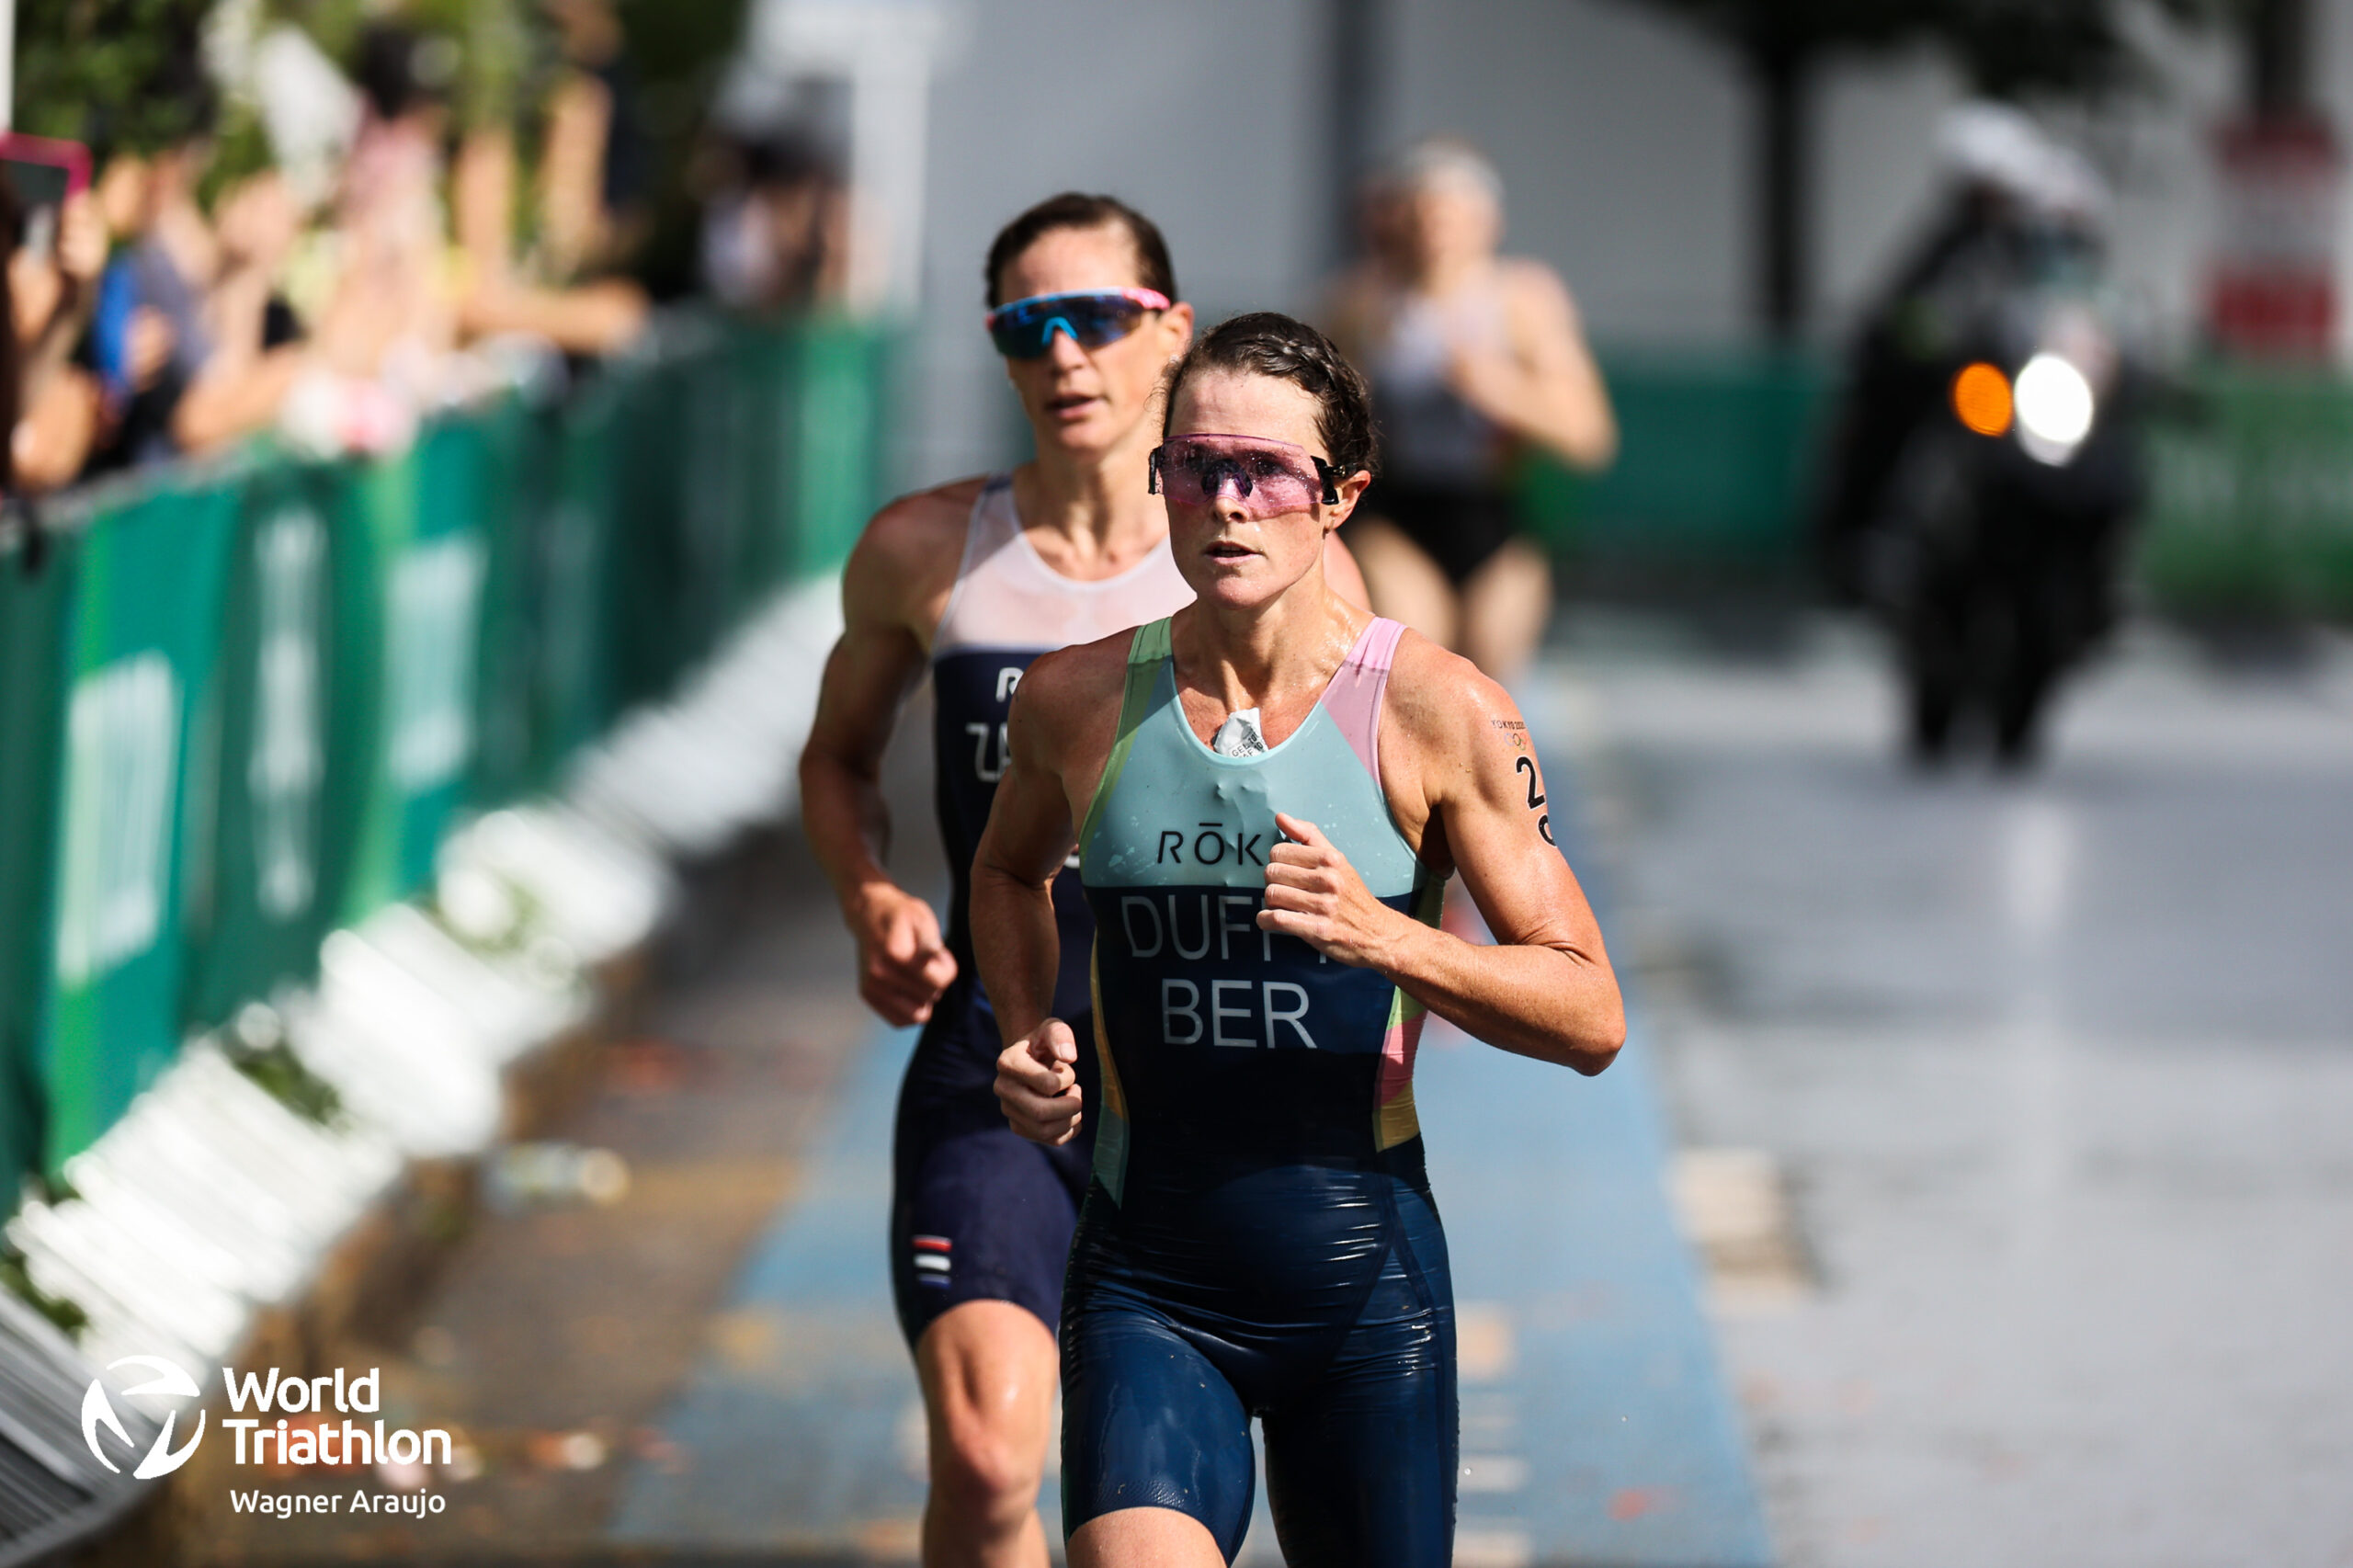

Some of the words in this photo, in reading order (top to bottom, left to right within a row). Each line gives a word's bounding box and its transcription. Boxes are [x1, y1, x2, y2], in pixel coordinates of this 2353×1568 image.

[1232, 743, 1251, 756] GEL
[1157, 823, 1265, 867] RŌK
[1120, 893, 1328, 964] DUF
[1162, 978, 1317, 1049] BER
